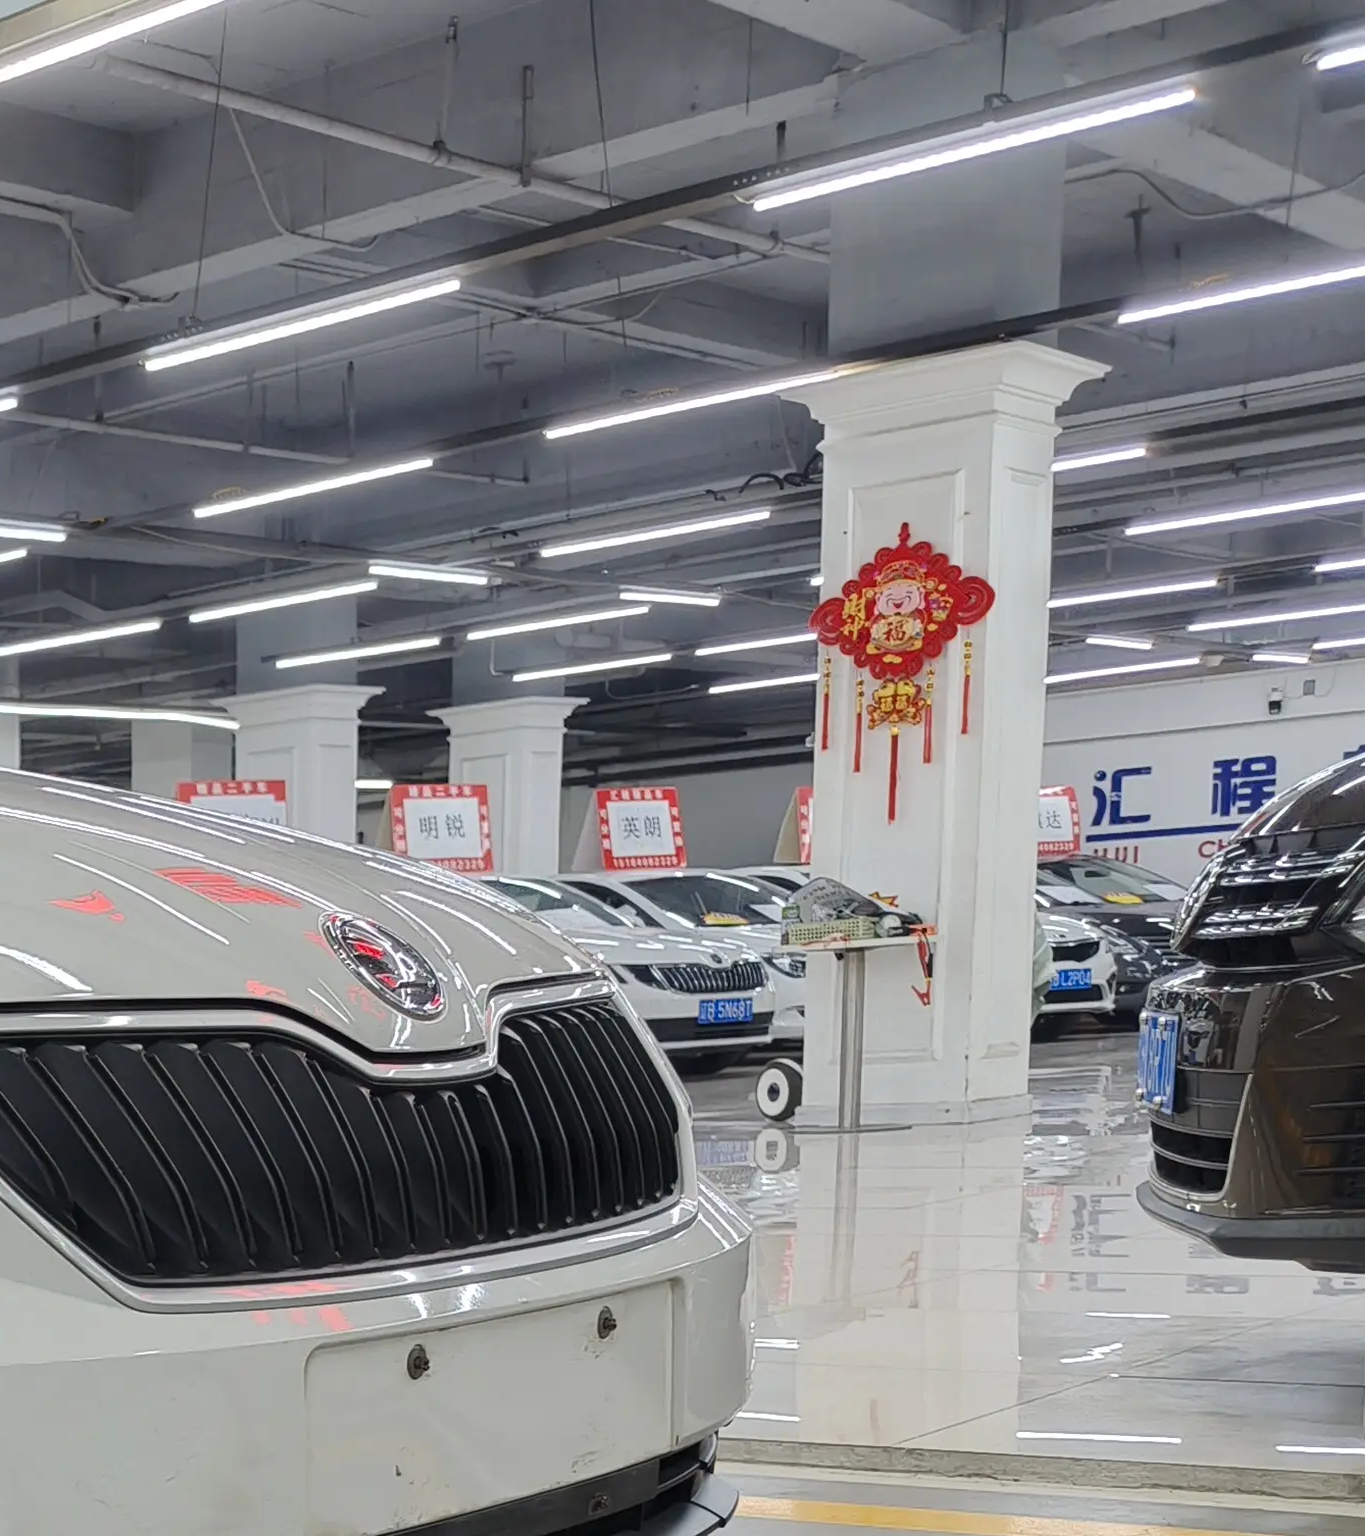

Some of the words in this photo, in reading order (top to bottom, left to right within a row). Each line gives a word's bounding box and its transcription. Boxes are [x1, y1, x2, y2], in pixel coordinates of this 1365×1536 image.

[883, 621, 907, 643] 福
[419, 813, 466, 840] 明锐
[621, 815, 662, 840] 英朗
[1038, 810, 1062, 829] 达
